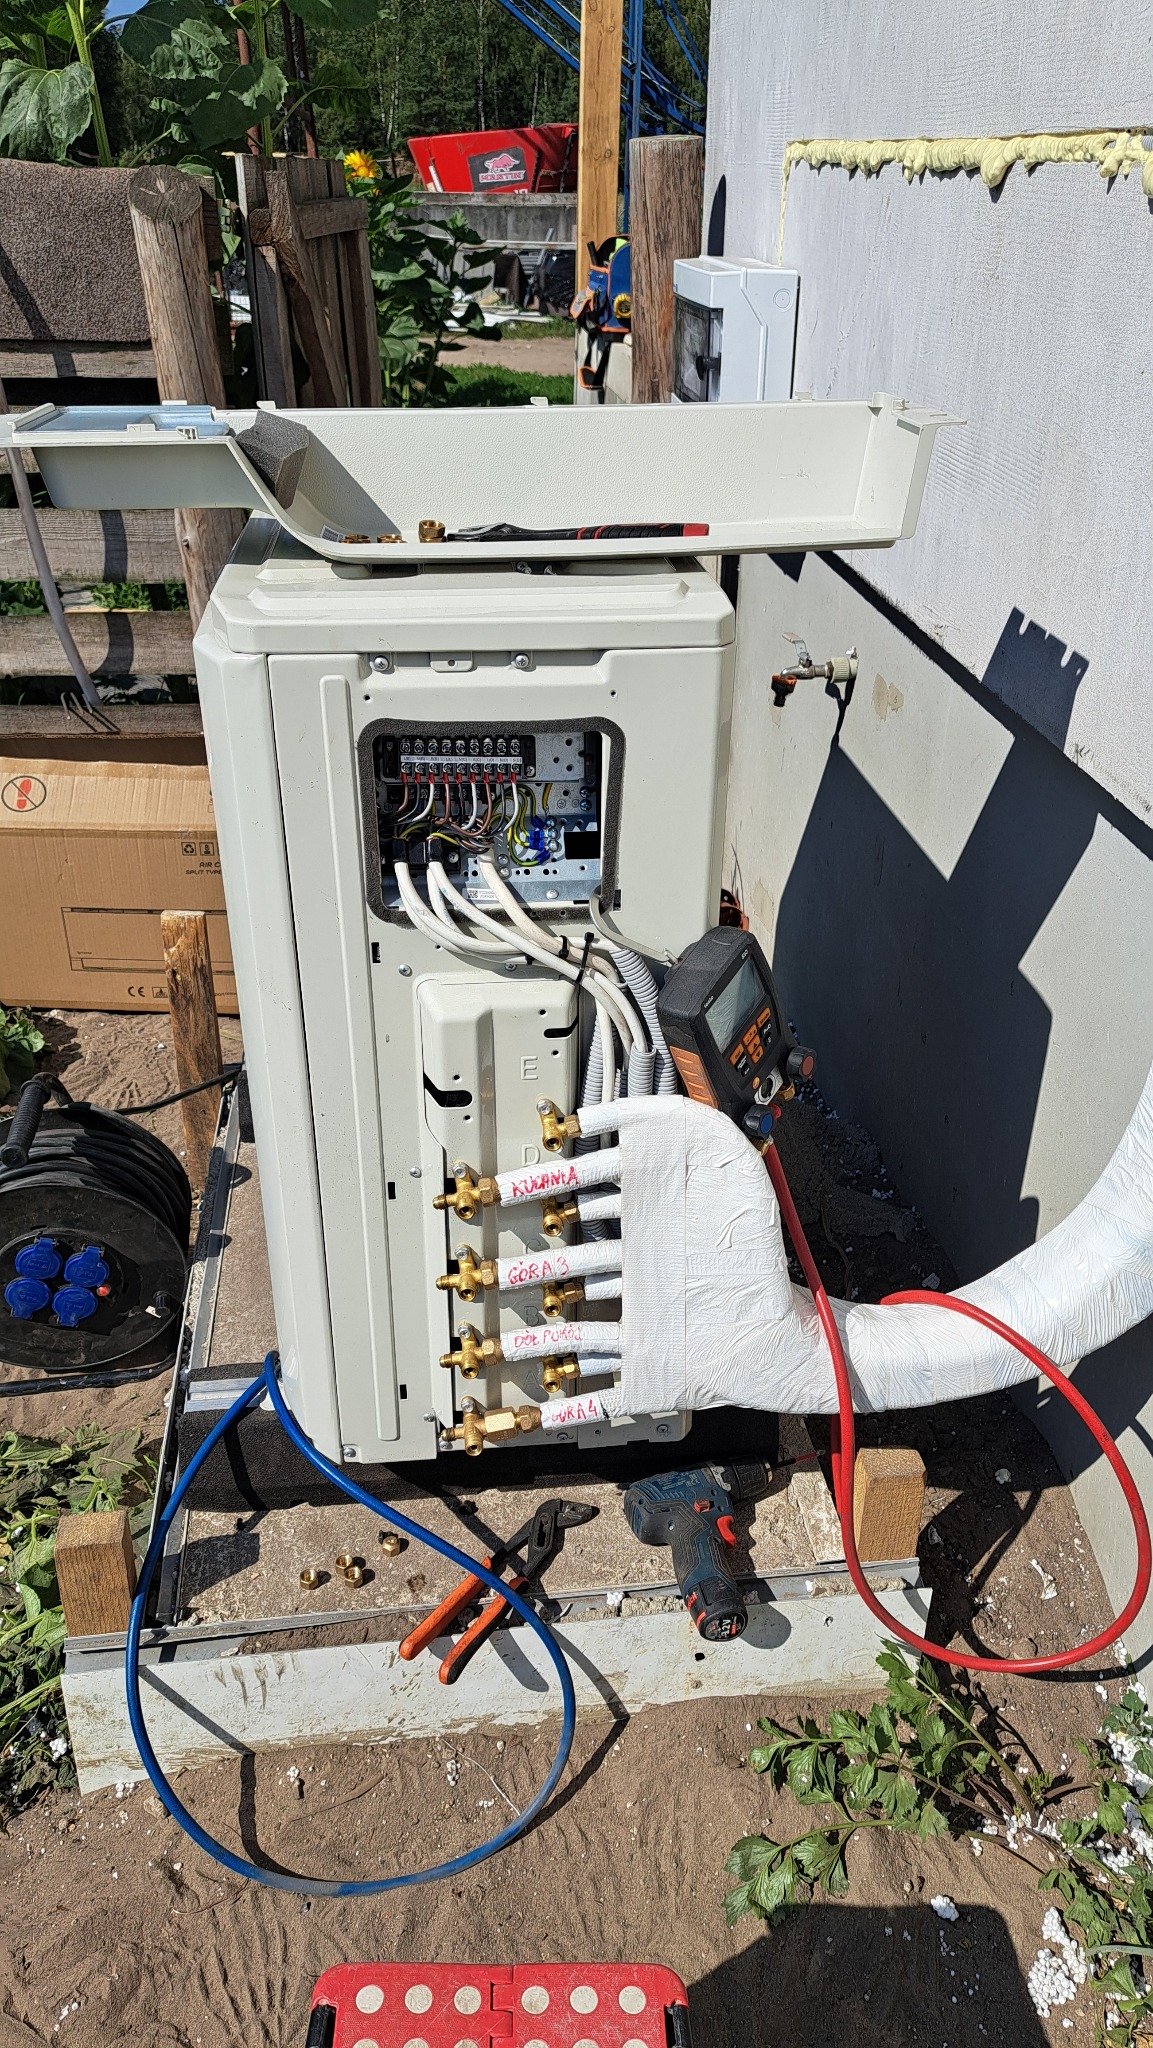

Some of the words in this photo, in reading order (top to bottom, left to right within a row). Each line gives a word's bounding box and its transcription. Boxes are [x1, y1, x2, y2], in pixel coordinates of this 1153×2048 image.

[521, 1056, 539, 1081] E
[521, 1143, 541, 1167] D
[507, 1260, 553, 1285] GÓRA
[556, 1256, 570, 1277] 3
[524, 1305, 541, 1327] B
[588, 1398, 599, 1417] 4
